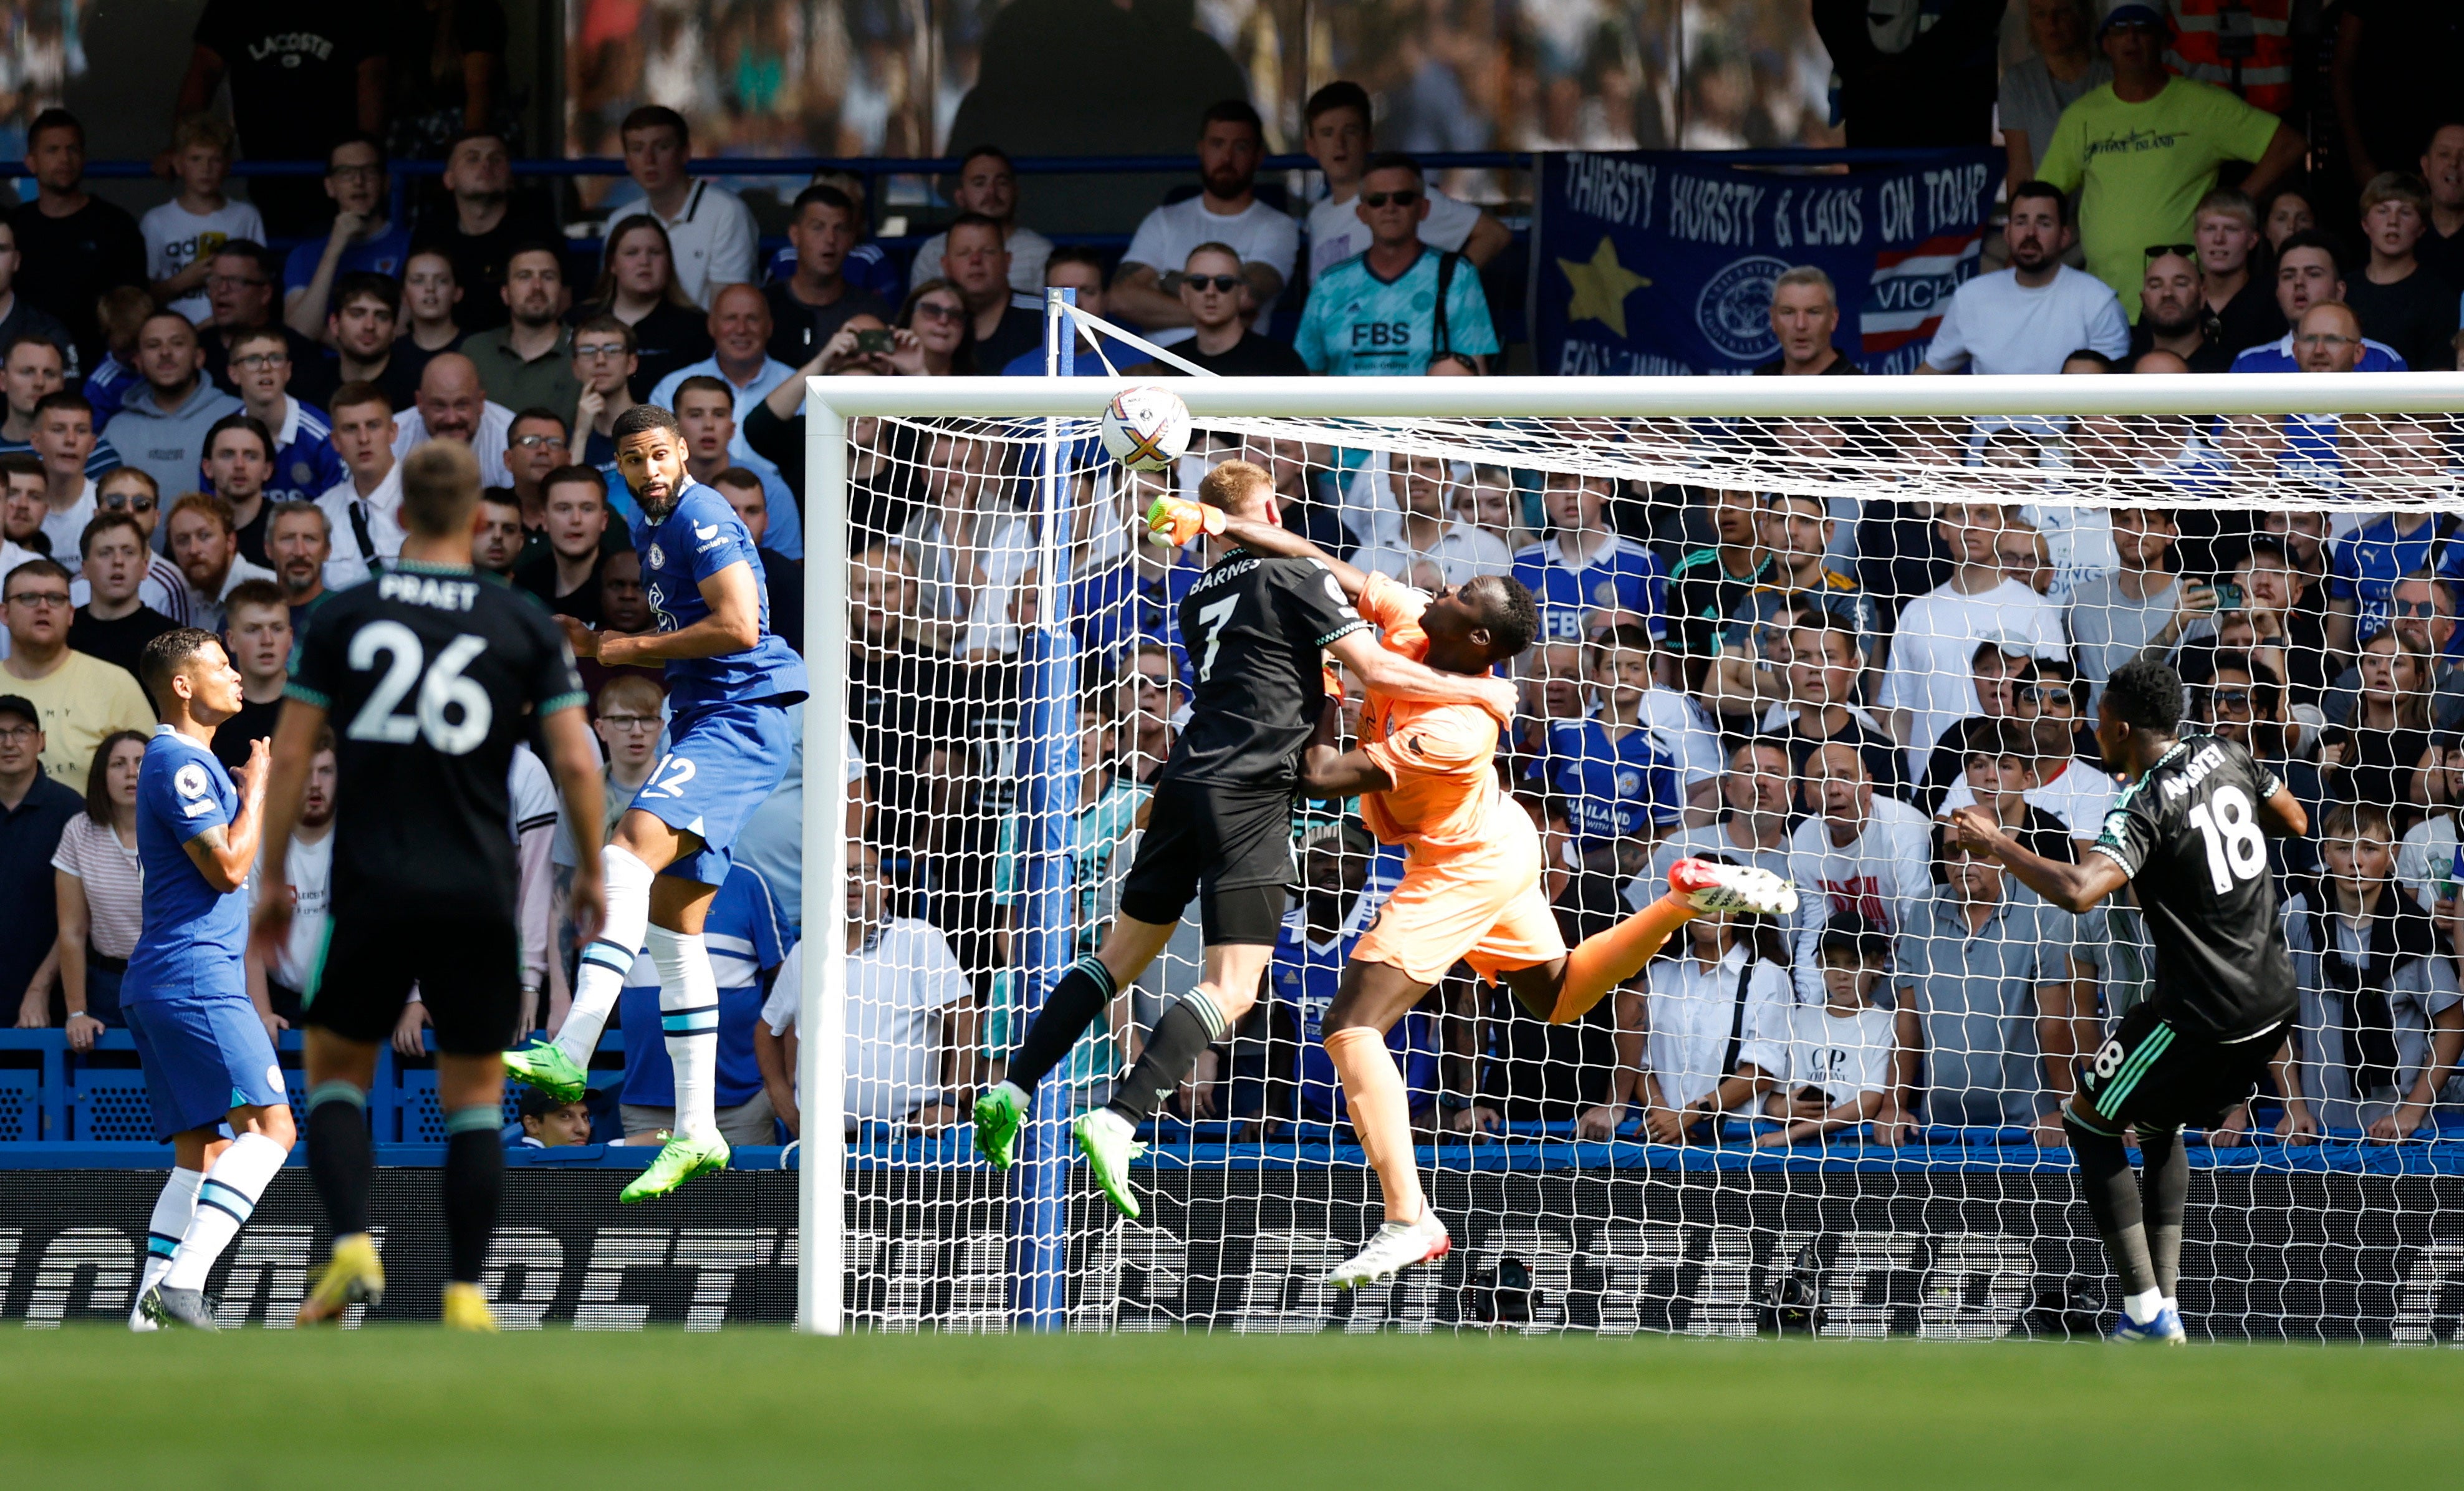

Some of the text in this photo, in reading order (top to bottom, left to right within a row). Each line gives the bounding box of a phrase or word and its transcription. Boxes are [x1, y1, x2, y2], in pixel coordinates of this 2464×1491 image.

[247, 31, 334, 61] LACOSTE
[1566, 153, 1986, 248] THIRSTY HURSTY & LADS ON TOUR
[1352, 322, 1410, 346] FBS
[379, 574, 480, 611] PRAET
[1189, 557, 1263, 596] BARNES
[1198, 593, 1239, 683] 7
[1541, 610, 1587, 638] FB
[346, 620, 492, 755] 26
[647, 753, 696, 798] 12
[2162, 743, 2226, 800] AMARTEY
[1586, 819, 1609, 831] WITH
[2188, 784, 2268, 895] 18
